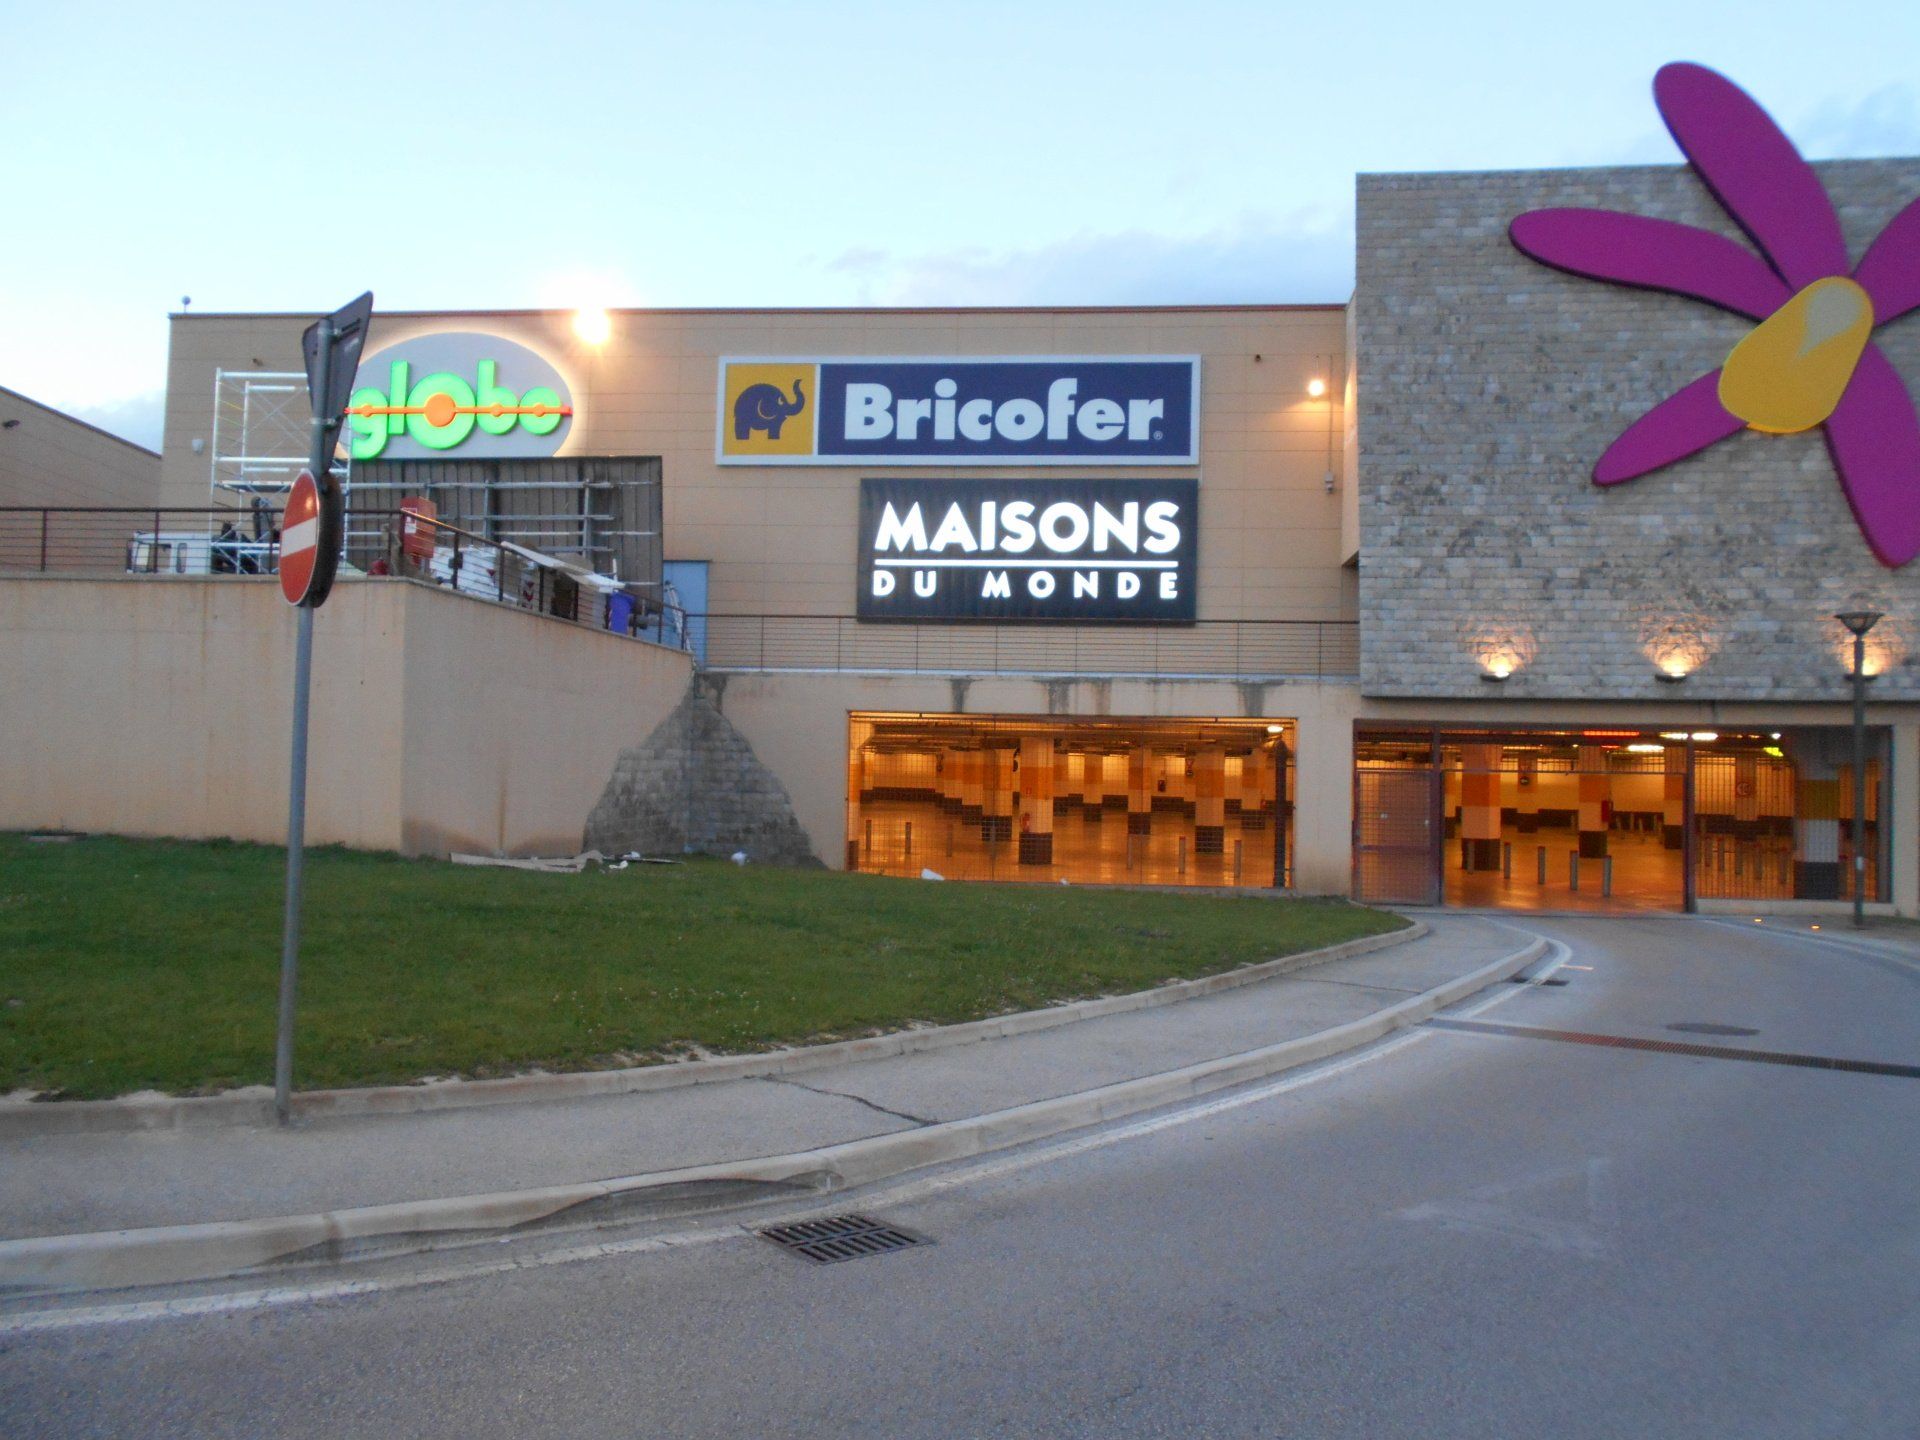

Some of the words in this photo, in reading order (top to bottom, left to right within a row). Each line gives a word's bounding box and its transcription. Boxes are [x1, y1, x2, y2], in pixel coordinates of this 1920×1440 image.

[844, 378, 1164, 441] Bricofer
[874, 501, 1181, 553] MAISONS
[872, 570, 937, 597] DU
[981, 570, 1178, 599] MONDE
